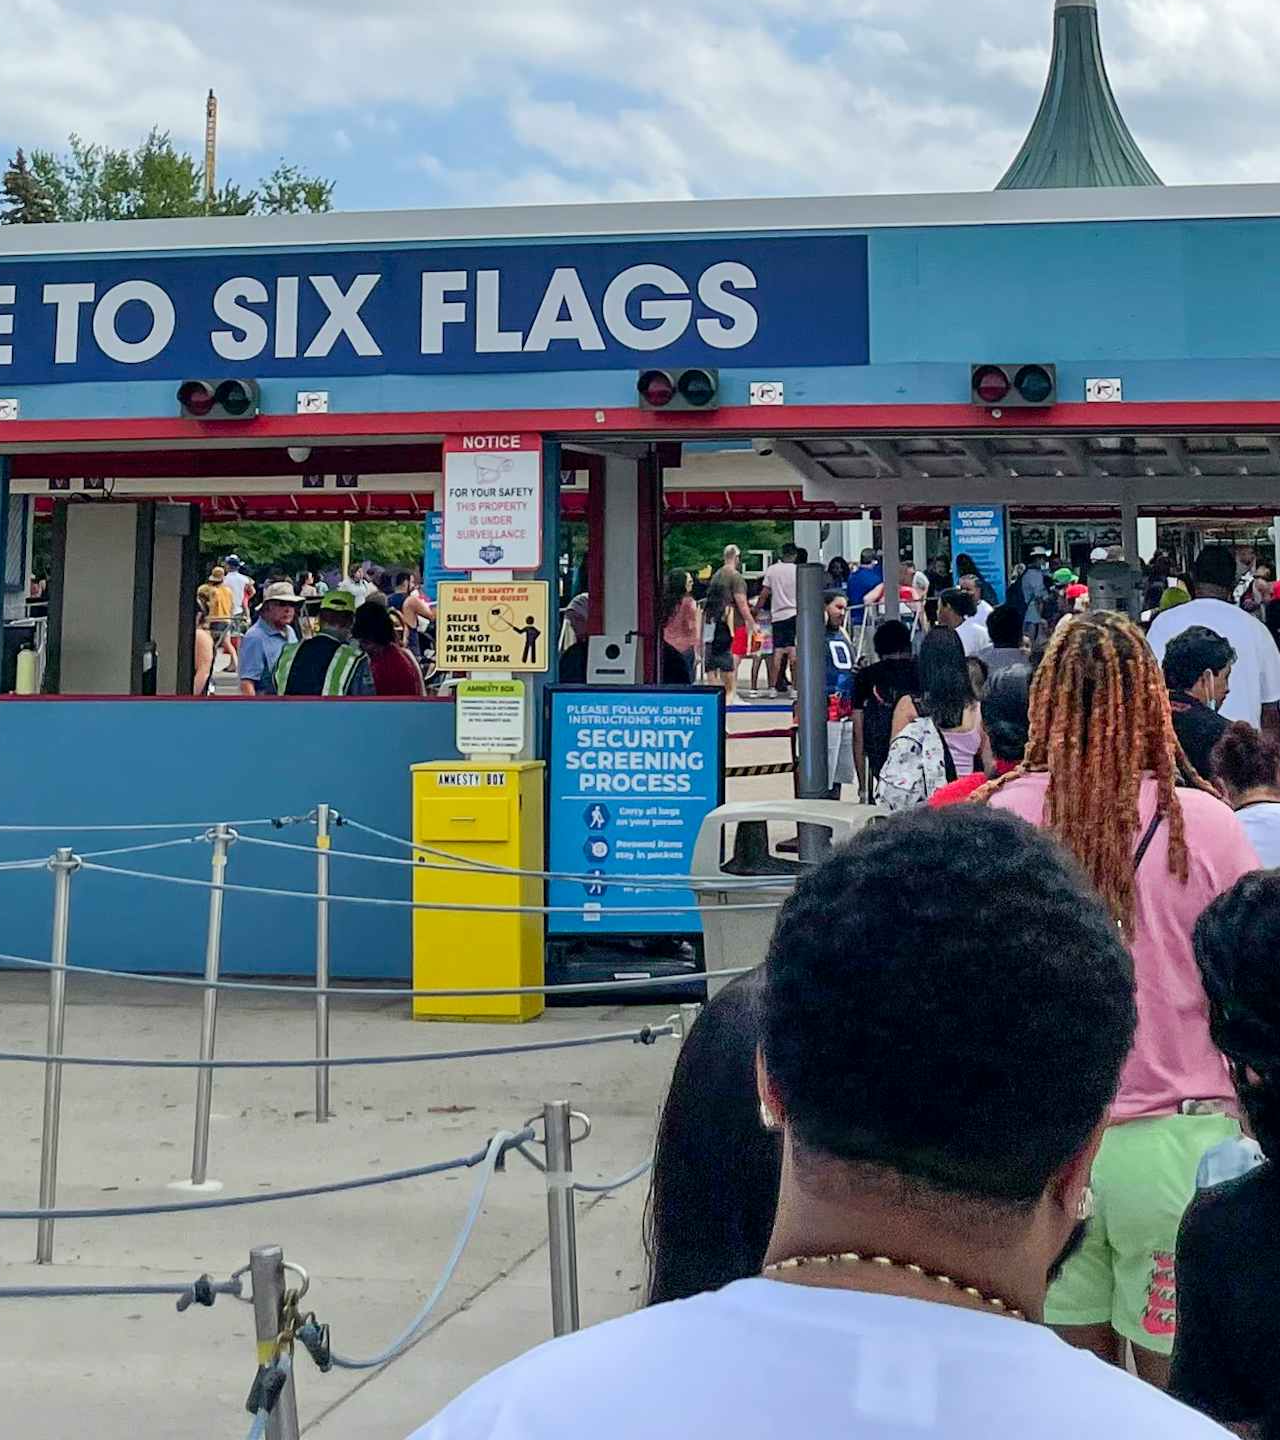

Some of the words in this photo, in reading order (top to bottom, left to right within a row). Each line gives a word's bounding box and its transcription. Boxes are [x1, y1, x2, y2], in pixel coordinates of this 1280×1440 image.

[42, 280, 176, 363] TO
[210, 274, 383, 360] SIX
[421, 262, 759, 354] FLAGS
[463, 435, 520, 448] NOTICE
[450, 488, 468, 497] FOR
[471, 488, 496, 497] YOUR
[499, 488, 533, 496] SAFETY
[456, 502, 476, 511] THIS
[478, 502, 528, 511] PROPERTY
[469, 516, 478, 525] IS
[480, 515, 512, 525] UNDER
[457, 529, 527, 539] SURVEILLANCE
[447, 614, 478, 622] SELFIE
[447, 624, 480, 632] STICKS
[567, 705, 608, 715] PLEASE
[612, 705, 659, 715] FOLLOW
[663, 706, 704, 715] SIMPLE
[569, 715, 651, 725] INSTRUCTIONS
[654, 716, 676, 725] FOR
[680, 716, 702, 725] THE
[577, 729, 694, 748] SECURITY
[566, 751, 704, 770] SCREENING
[438, 773, 480, 785] AMNESTY
[487, 773, 504, 785] BOX
[579, 773, 691, 792] PROCESS
